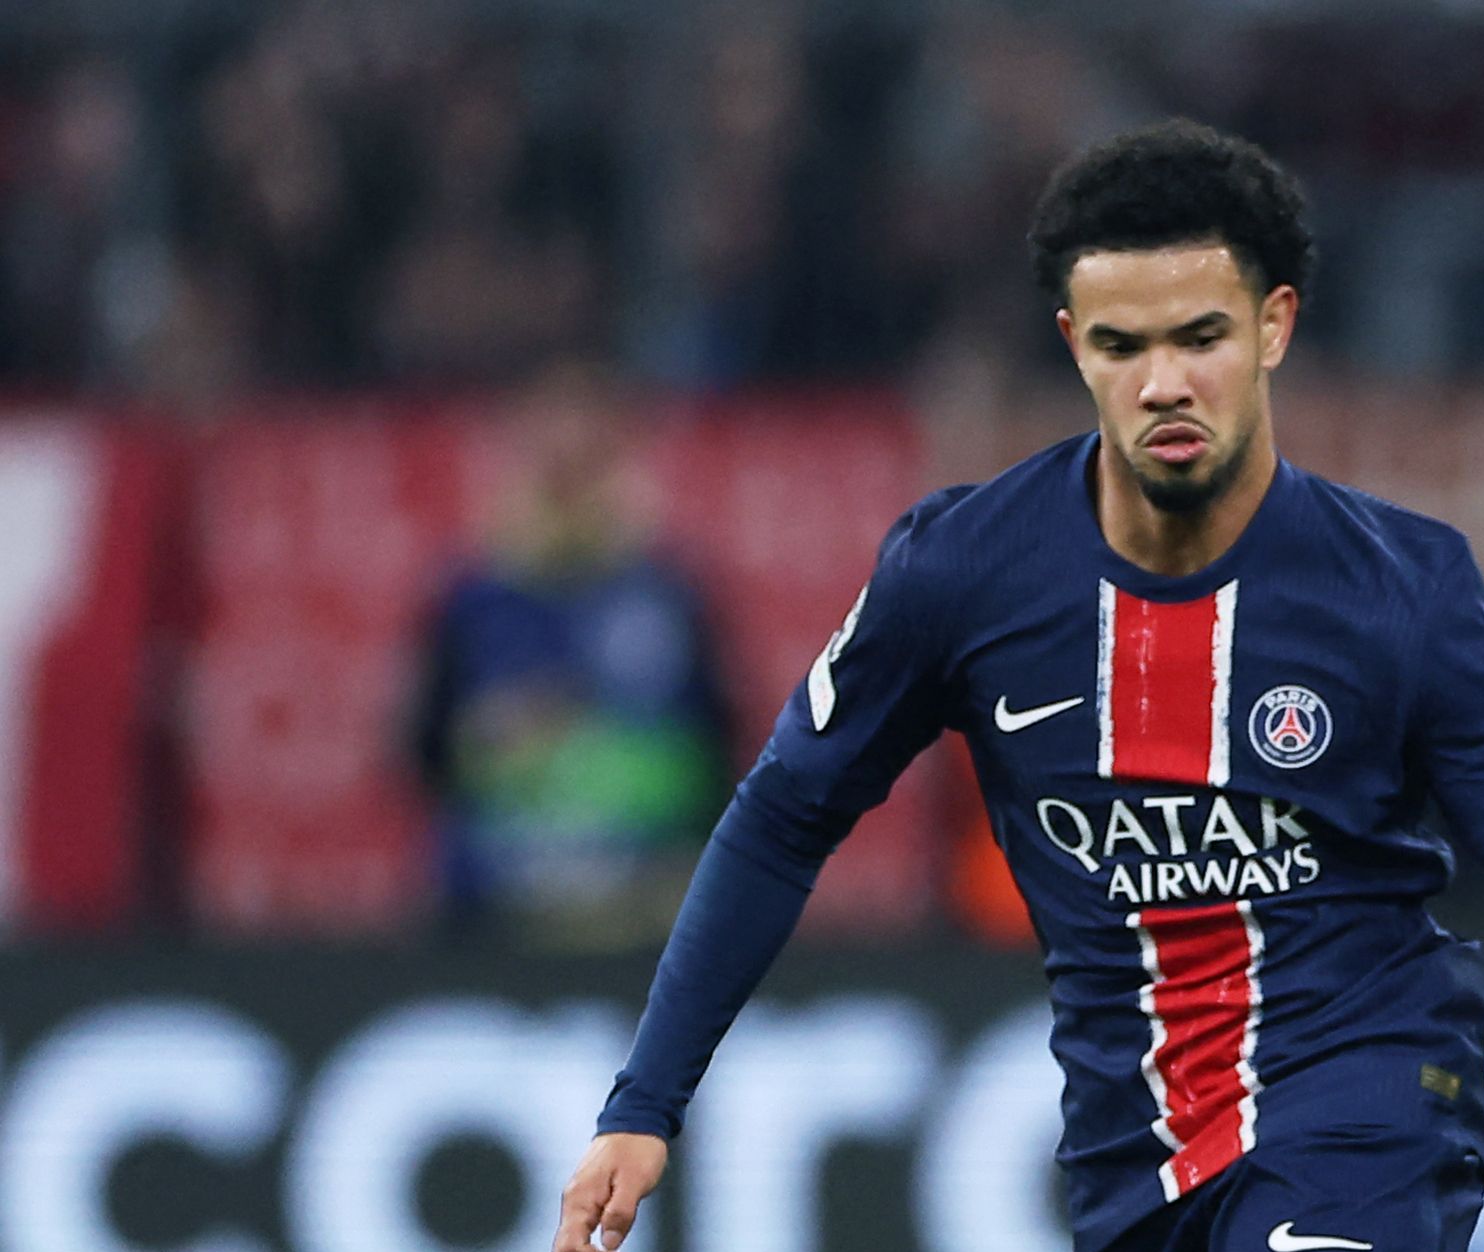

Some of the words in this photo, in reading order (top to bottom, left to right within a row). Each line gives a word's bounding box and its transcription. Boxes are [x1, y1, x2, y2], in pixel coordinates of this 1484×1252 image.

[1263, 690, 1318, 713] PARIS
[1036, 795, 1309, 874] QATAR
[1108, 842, 1320, 903] AIRWAYS
